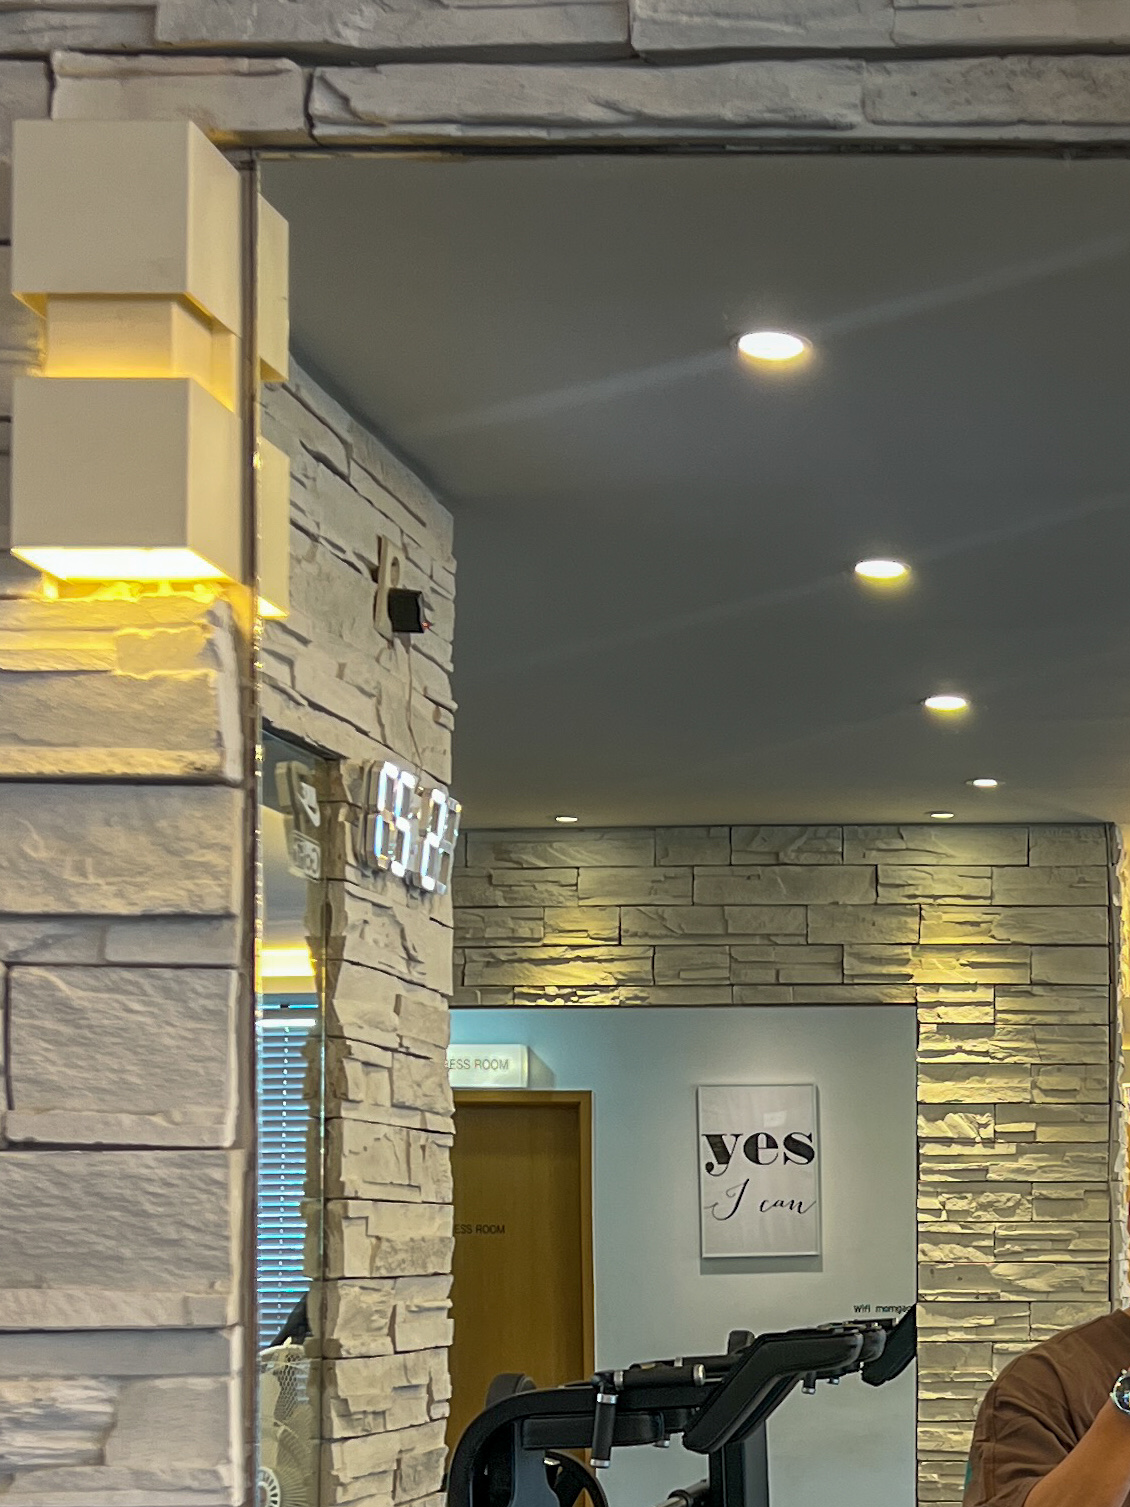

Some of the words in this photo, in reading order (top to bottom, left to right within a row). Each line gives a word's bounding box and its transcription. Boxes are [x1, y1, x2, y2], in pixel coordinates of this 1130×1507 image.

[474, 1058, 509, 1070] ROOM
[701, 1131, 815, 1177] yes
[704, 1178, 750, 1221] I
[759, 1199, 817, 1215] can
[476, 1224, 505, 1234] ROOM
